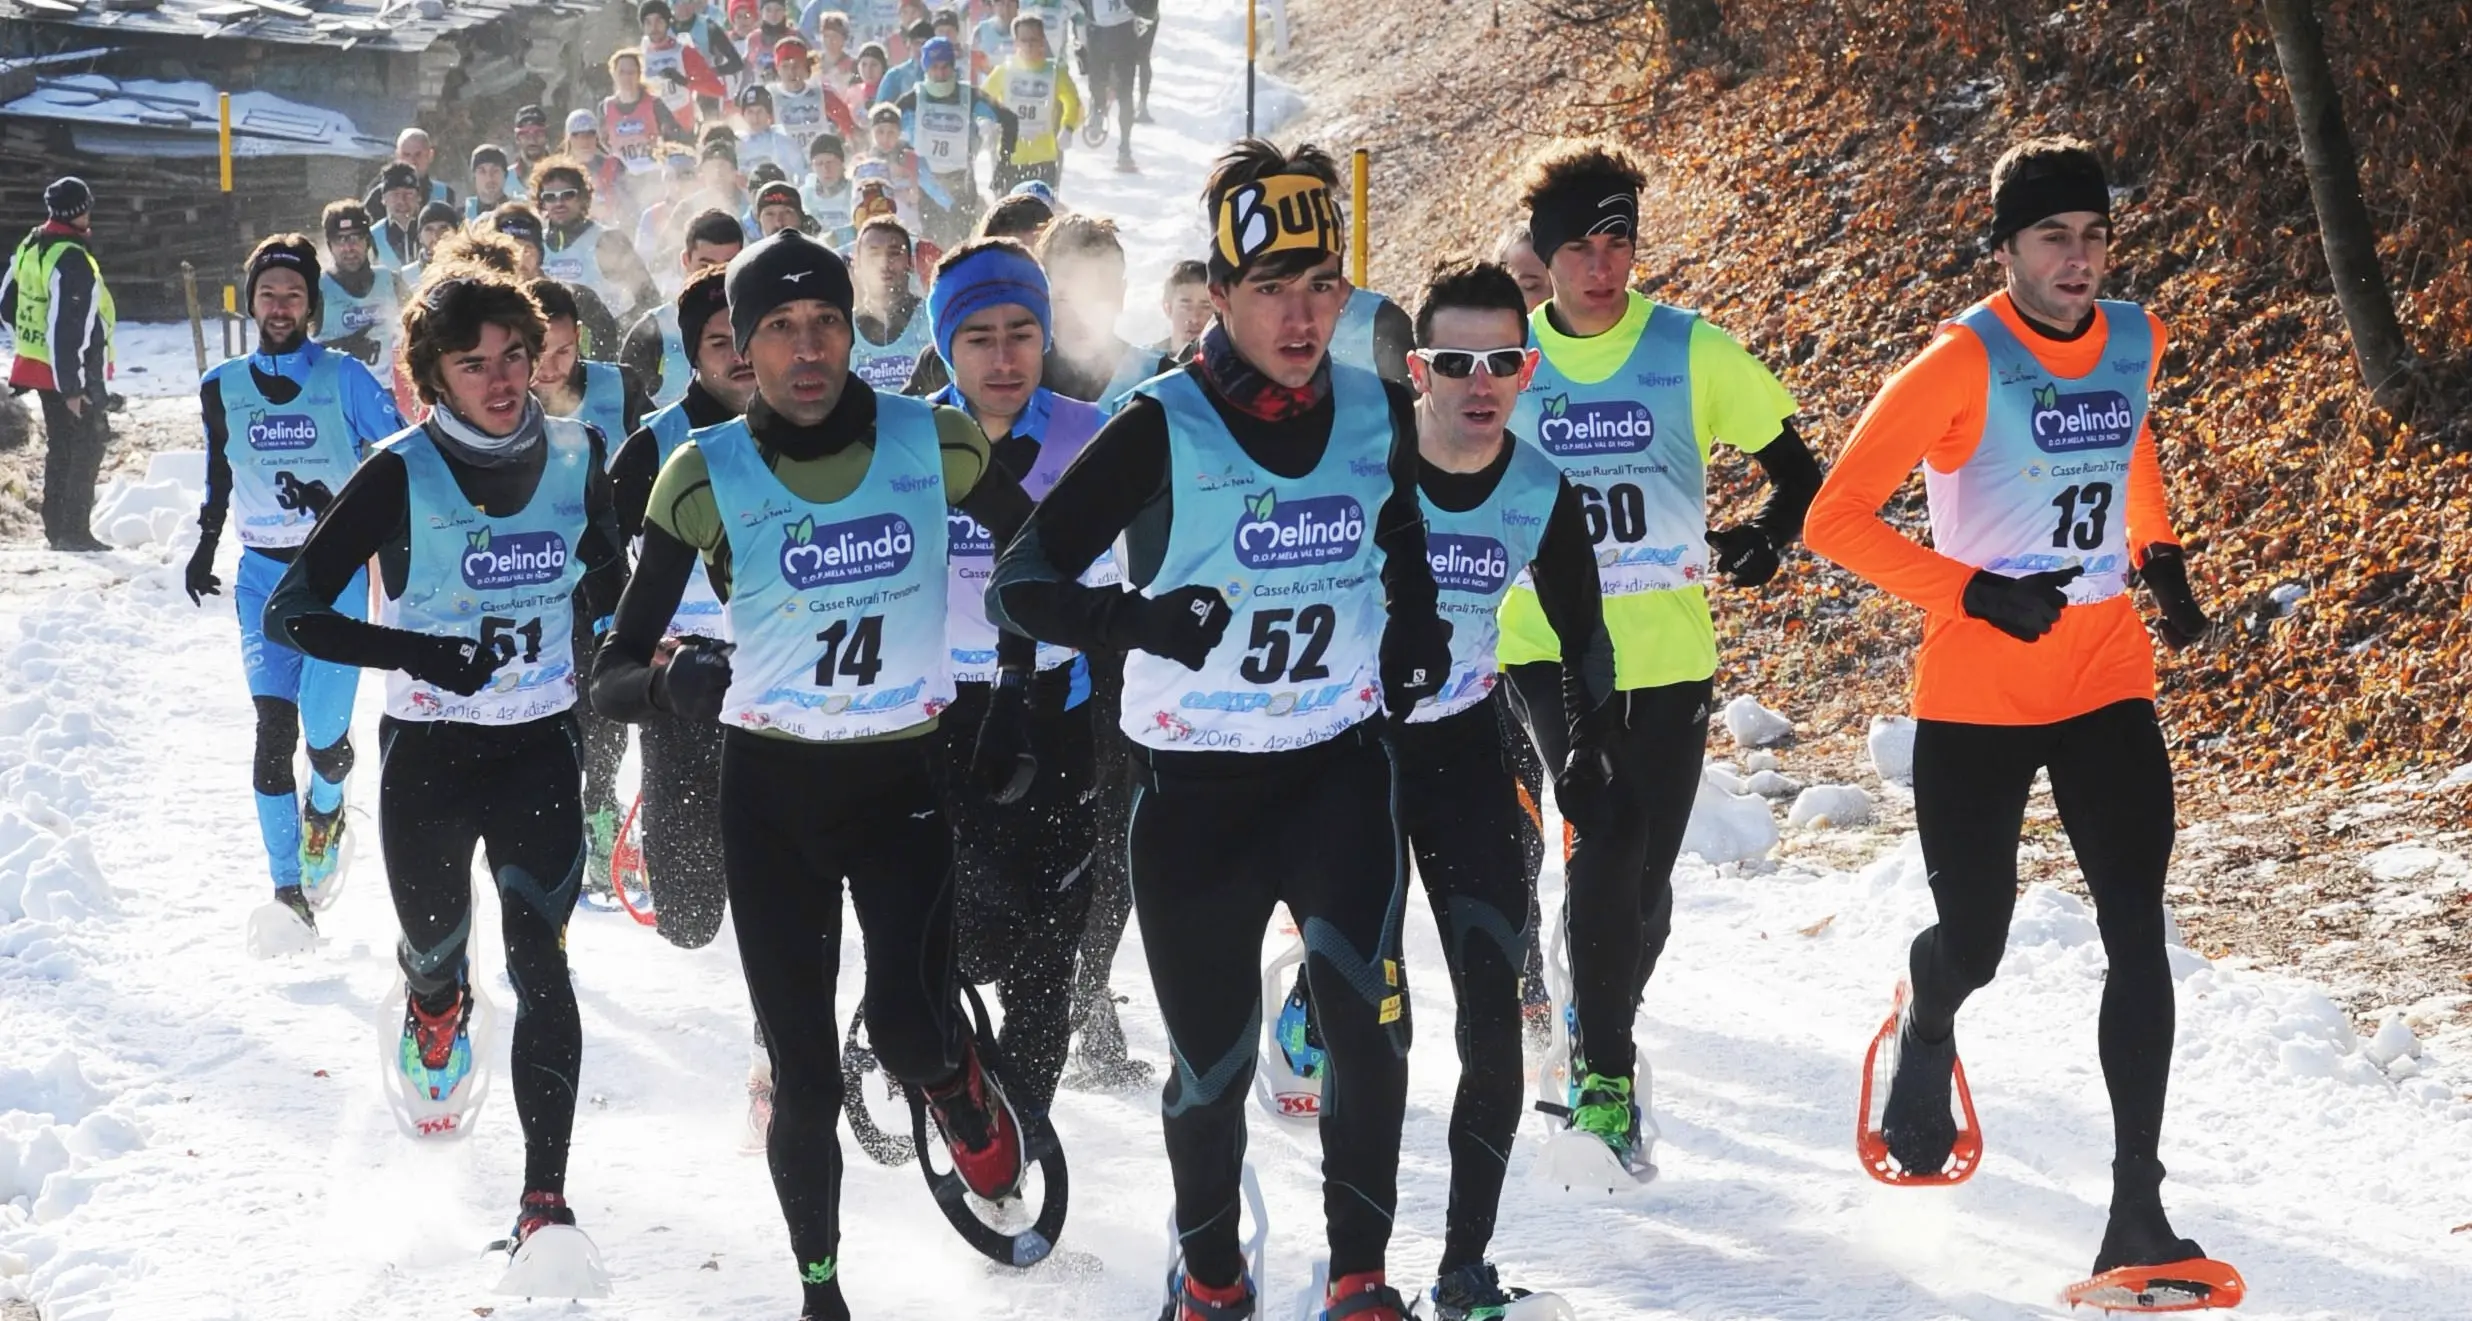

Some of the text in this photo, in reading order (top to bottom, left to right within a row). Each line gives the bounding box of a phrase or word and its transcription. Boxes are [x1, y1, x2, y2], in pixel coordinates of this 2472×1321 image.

[1017, 105, 1037, 120] 98
[931, 140, 950, 157] 78
[249, 420, 316, 443] Melinda
[1541, 411, 1650, 441] Melinda
[2034, 402, 2132, 436] Melinda
[1593, 465, 1624, 477] Rurali
[2051, 466, 2081, 478] Casse
[1575, 483, 1647, 544] 60
[2051, 481, 2113, 551] 13
[1239, 508, 1363, 550] Melinda
[464, 540, 566, 577] Melinda
[784, 525, 912, 575] Melinda
[1426, 544, 1506, 578] elinda
[847, 566, 862, 576] VAL
[863, 564, 873, 574] DI
[874, 561, 895, 571] NON
[959, 568, 991, 579] Casse
[808, 598, 845, 613] Casse
[846, 592, 880, 607] Rurali
[1253, 585, 1290, 598] Casse
[1438, 602, 1469, 614] Rurali
[480, 616, 542, 668] 51
[815, 614, 885, 687] 14
[1240, 603, 1336, 684] 52
[1193, 729, 1242, 748] 2016
